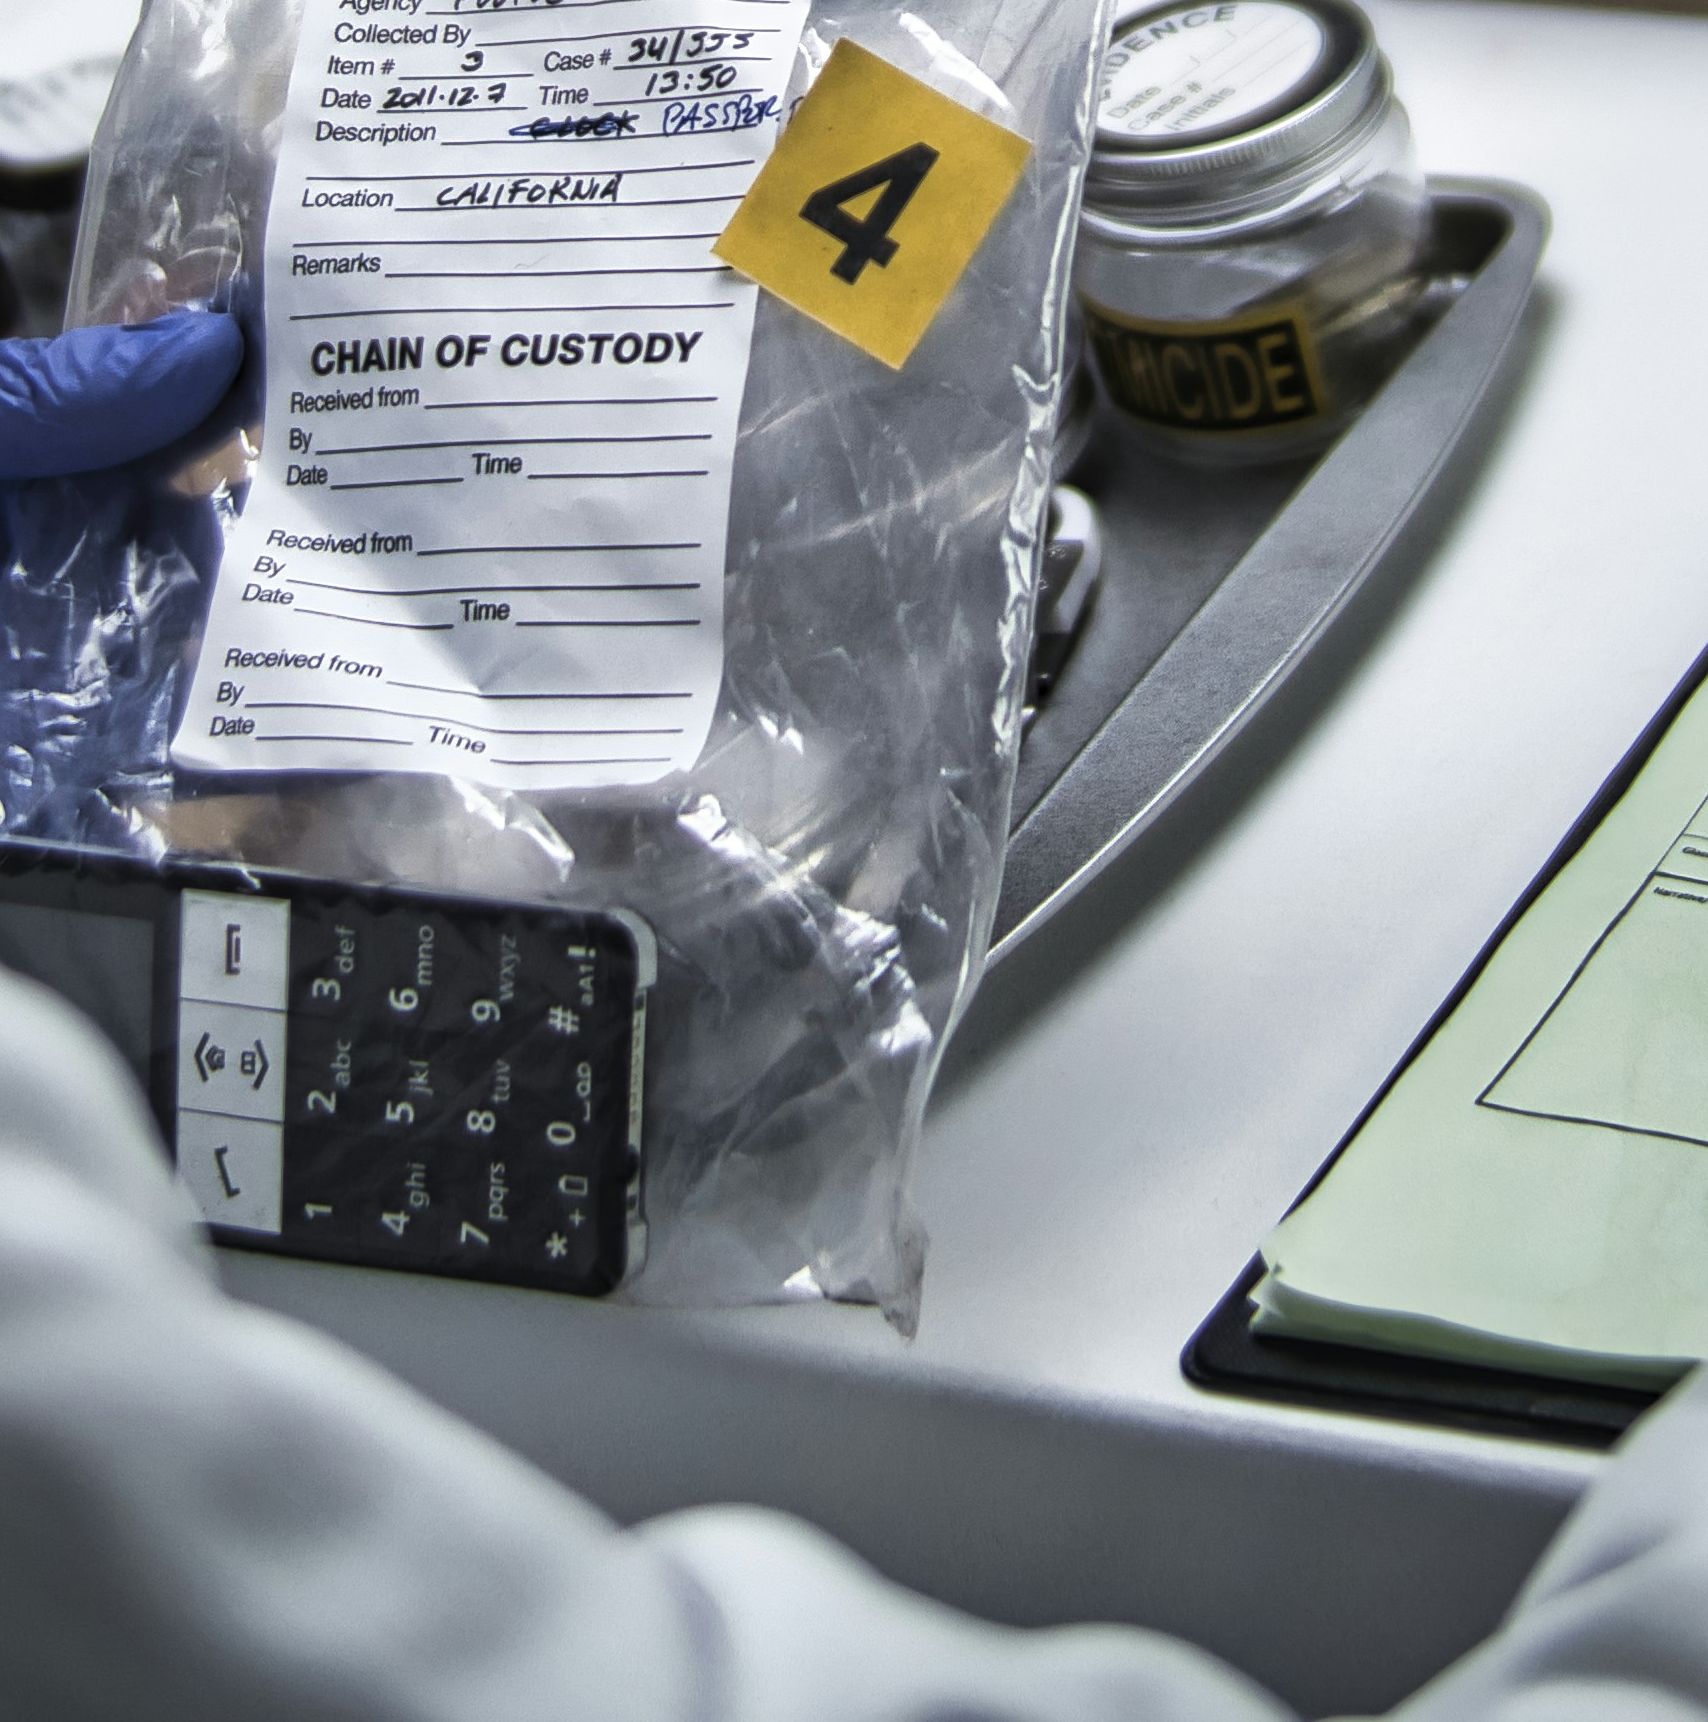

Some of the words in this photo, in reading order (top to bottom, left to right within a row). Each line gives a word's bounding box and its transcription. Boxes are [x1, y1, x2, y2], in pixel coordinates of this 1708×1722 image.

[334, 22, 444, 47] Collected
[448, 26, 472, 48] By
[327, 53, 374, 77] Item
[380, 57, 395, 75] #
[461, 50, 484, 72] 3
[544, 49, 594, 72] Case
[597, 48, 613, 67] #
[539, 86, 589, 106] Time
[645, 64, 737, 97] 13:50
[321, 87, 372, 110] Date
[1106, 86, 1162, 119] Date
[1127, 94, 1186, 131] Case
[1165, 87, 1237, 131] Initials
[315, 122, 437, 146] Description
[301, 189, 394, 209] Location
[436, 173, 624, 207] CALIFORNIA
[798, 141, 941, 286] 4
[293, 254, 382, 277] Remarks
[311, 336, 424, 377] CHAIN
[435, 334, 489, 367] OF
[500, 331, 703, 366] CUSTODY
[290, 389, 374, 415] Received
[378, 386, 420, 408] from
[288, 428, 313, 455] By
[286, 464, 329, 487] Date
[471, 452, 523, 475] Time
[266, 530, 367, 554] Received
[369, 532, 414, 555] from
[253, 556, 287, 580] By
[241, 583, 295, 607] Date
[459, 599, 511, 622] Time
[224, 648, 326, 671] Received
[328, 654, 384, 679] from
[215, 681, 244, 707] By
[209, 716, 256, 738] Date
[427, 726, 487, 755] Time
[311, 976, 342, 1002] 3
[333, 924, 356, 975] def
[389, 988, 419, 1012] 6
[416, 924, 436, 985] mno
[471, 997, 502, 1023] 9
[495, 933, 519, 1001] wxyz
[548, 1005, 579, 1034] #
[309, 1089, 338, 1114] 2
[332, 1039, 353, 1088] abc
[387, 1101, 416, 1125] 5
[408, 1059, 430, 1096] jkl
[467, 1108, 497, 1133] 8
[493, 1059, 511, 1104] tuv
[546, 1122, 577, 1146] 0
[305, 1200, 335, 1219] 1
[381, 1210, 410, 1238] 4
[409, 1160, 430, 1208] ghi
[461, 1221, 490, 1247] 7
[486, 1160, 507, 1222] pqrs
